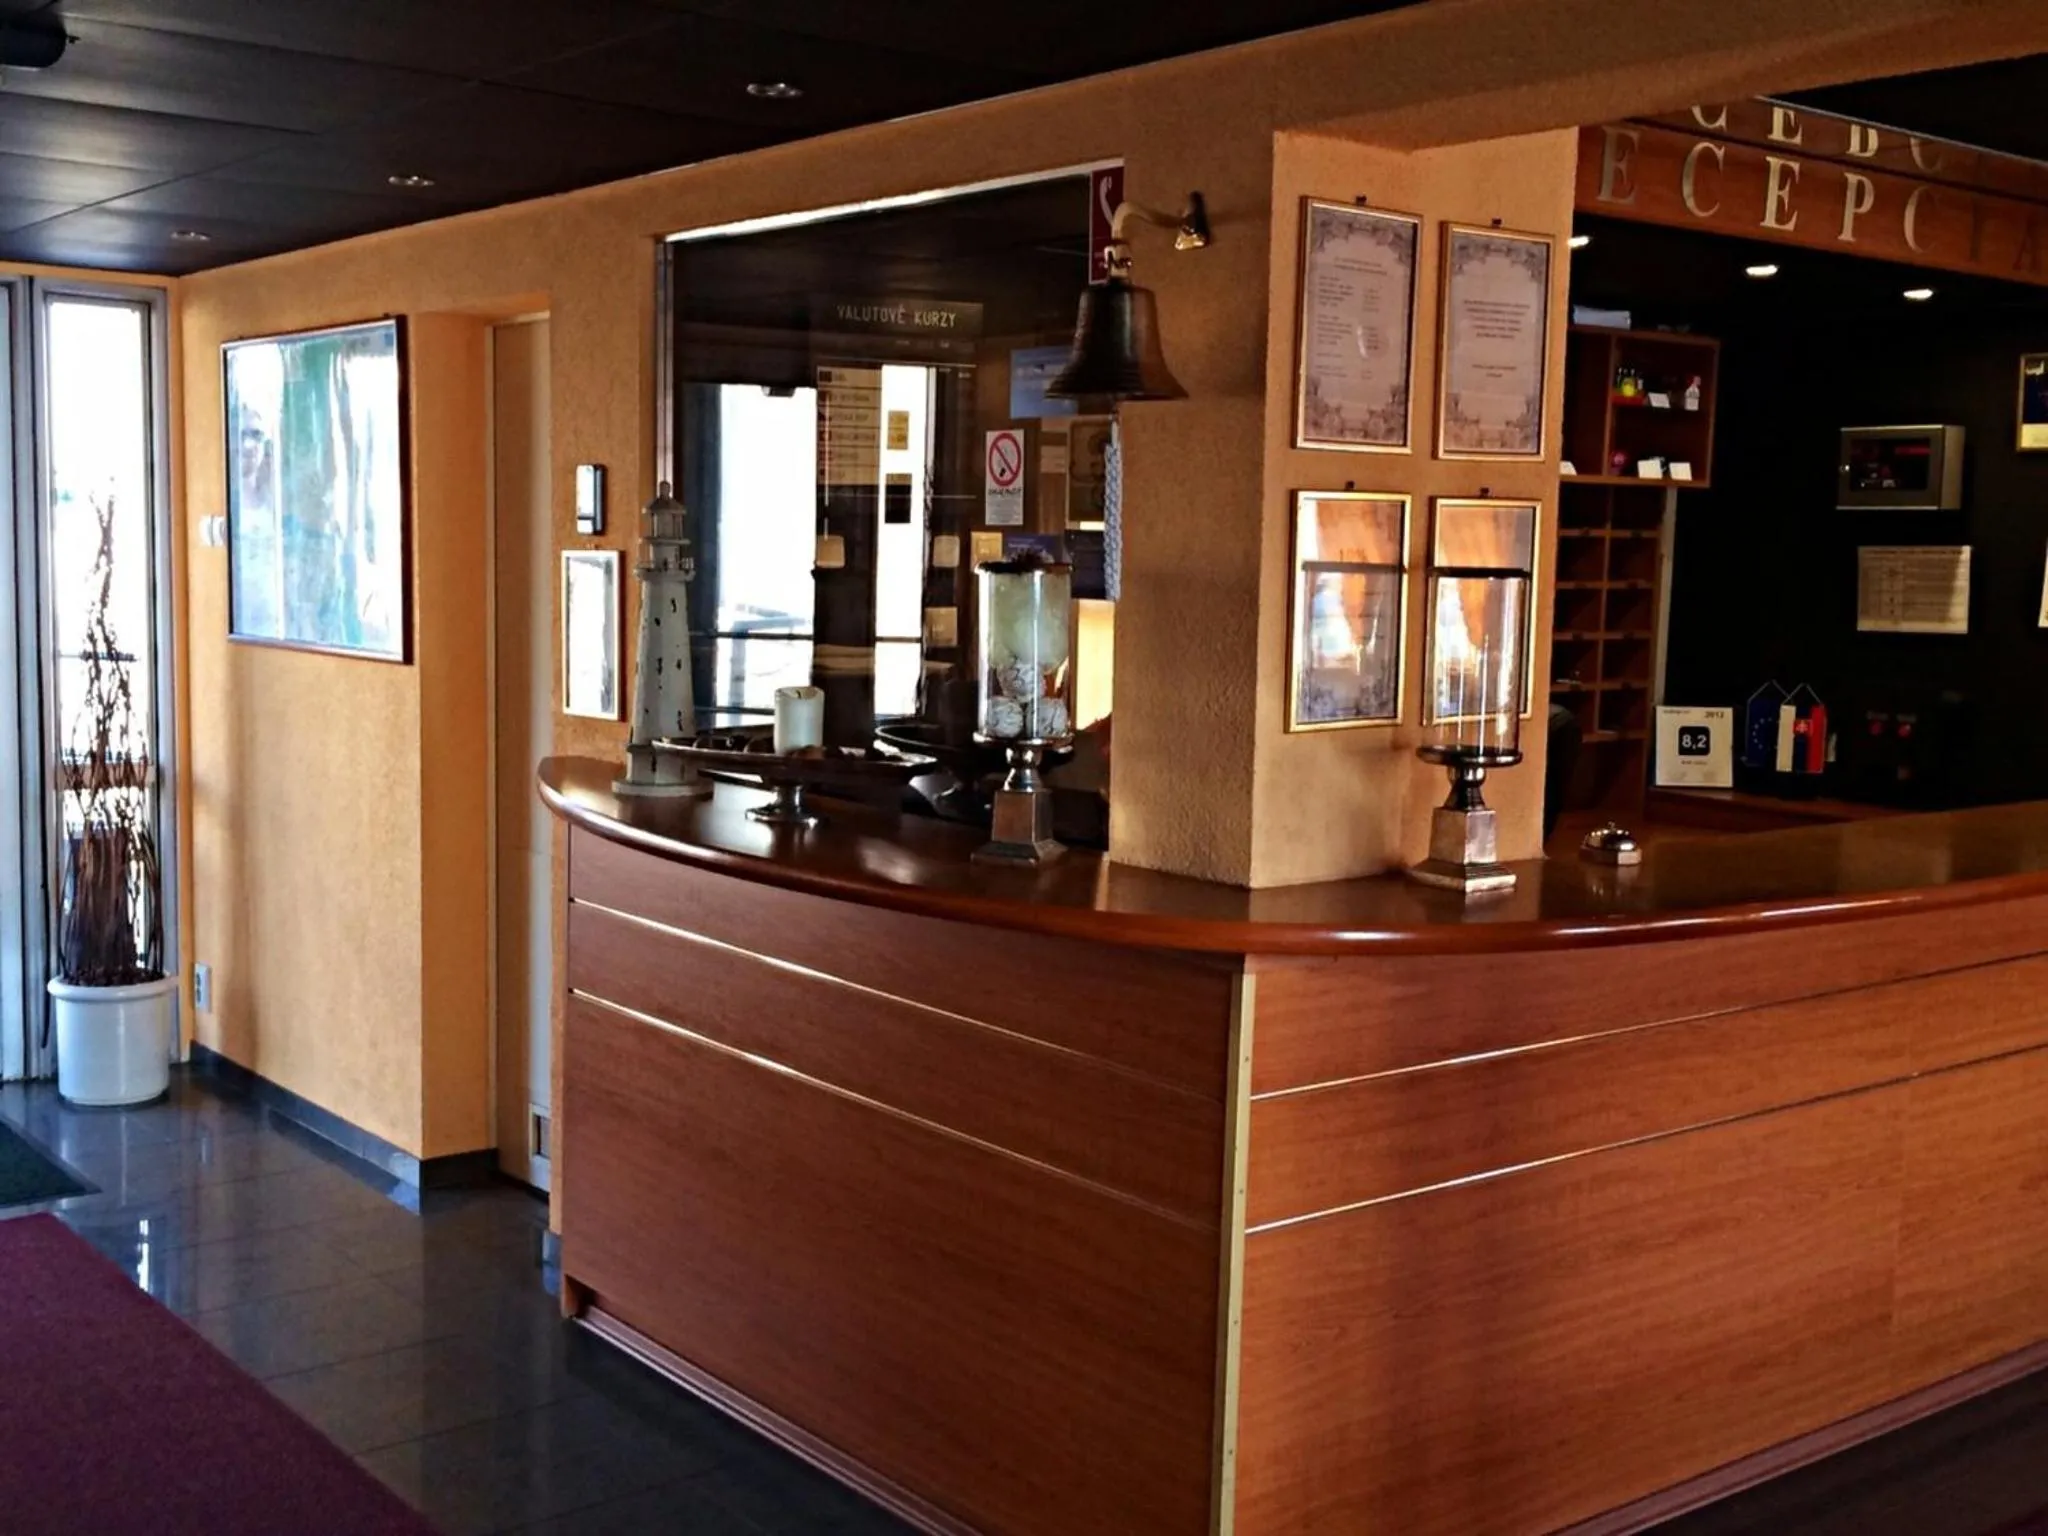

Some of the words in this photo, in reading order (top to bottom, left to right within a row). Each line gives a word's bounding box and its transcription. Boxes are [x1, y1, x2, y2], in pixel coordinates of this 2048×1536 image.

[836, 304, 906, 324] VALUTOVÉ
[913, 309, 957, 328] KURZY
[1682, 734, 1707, 749] 8,2
